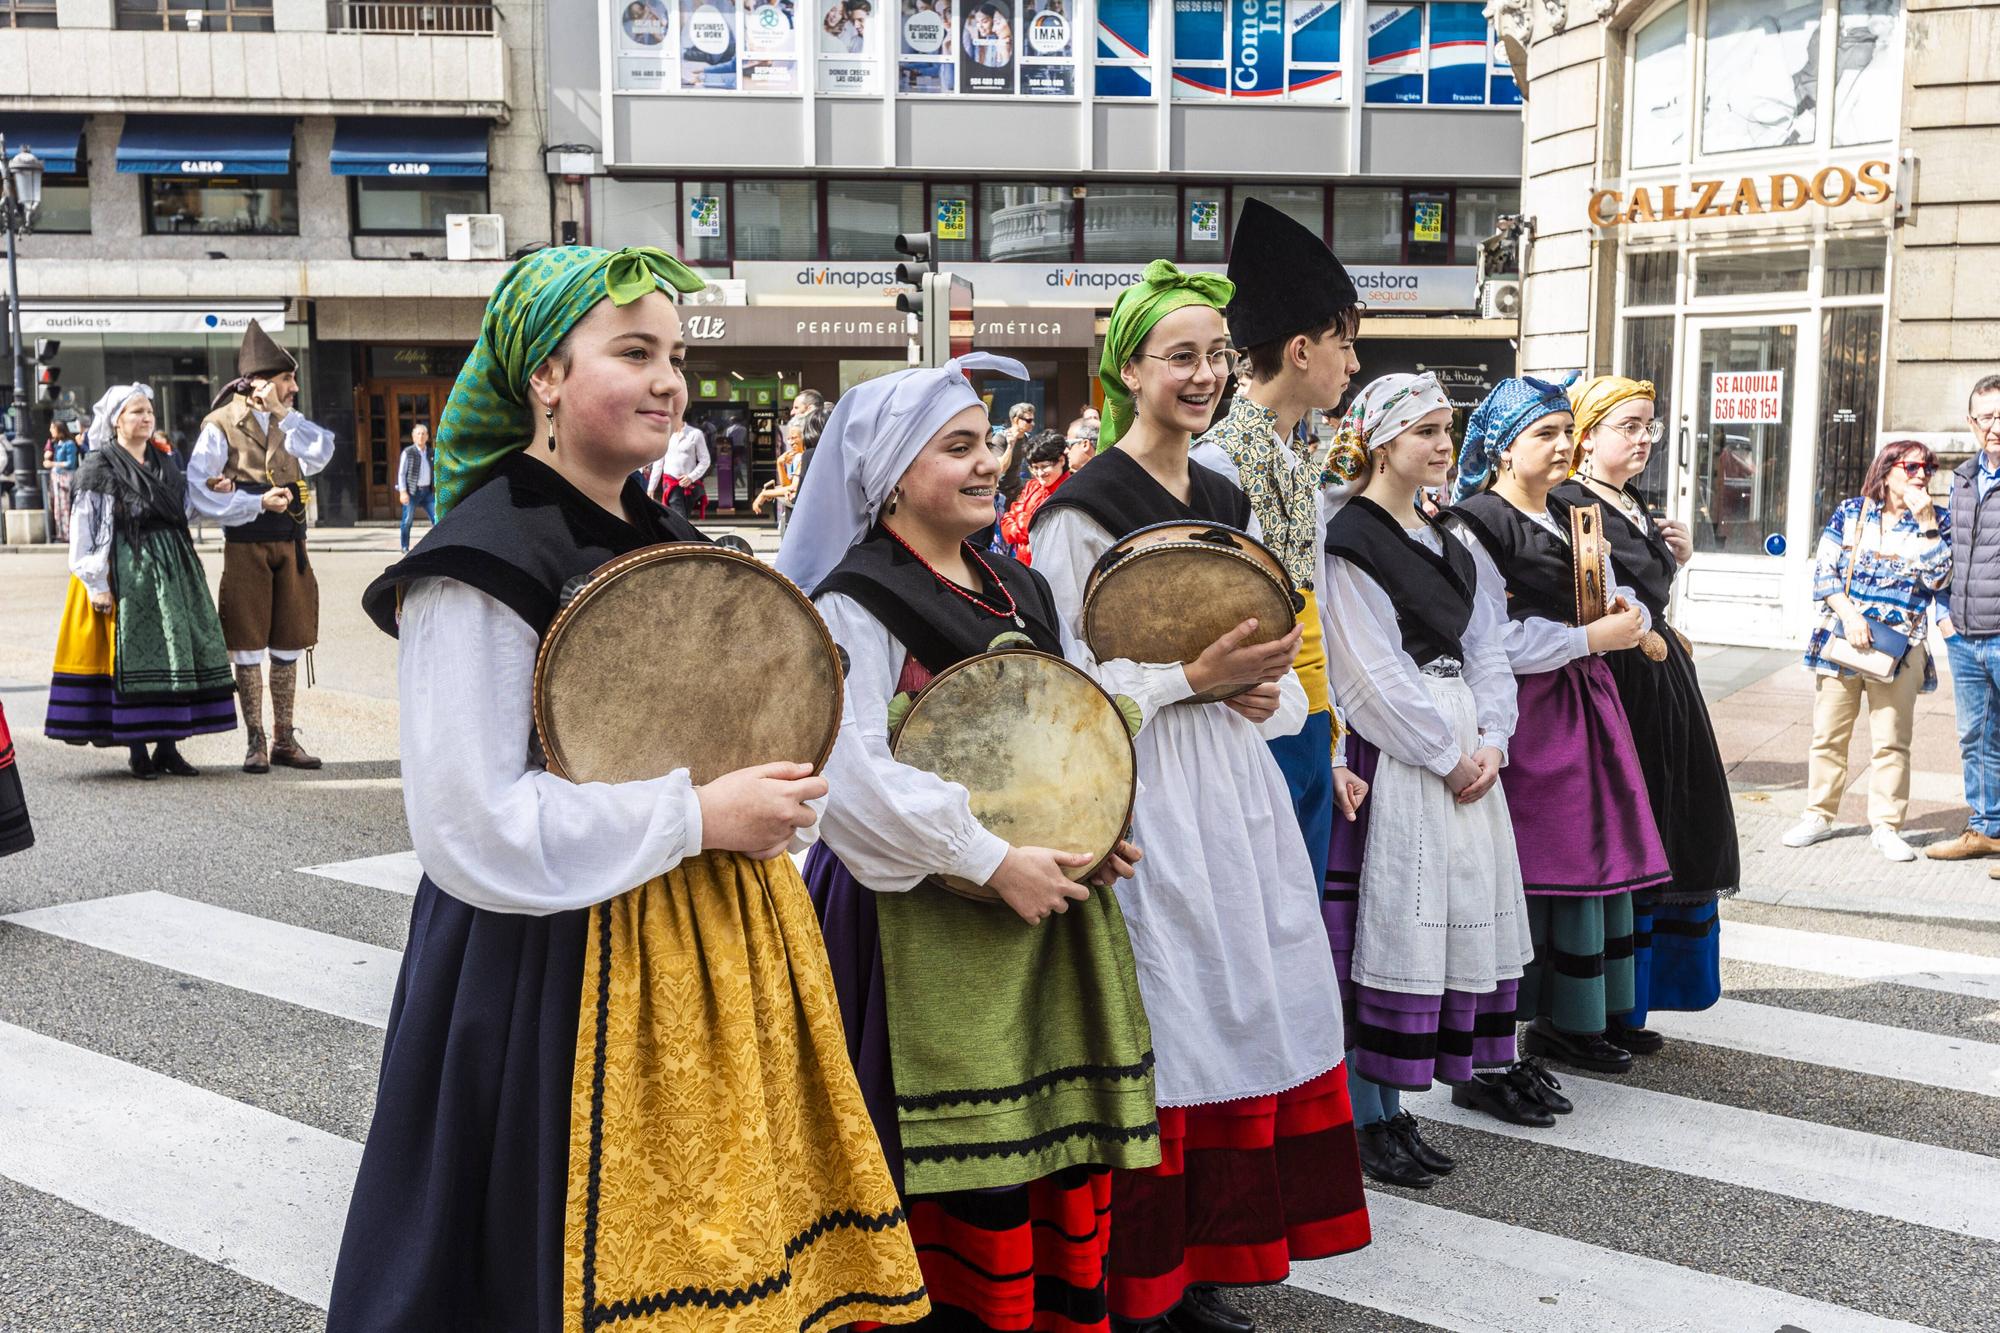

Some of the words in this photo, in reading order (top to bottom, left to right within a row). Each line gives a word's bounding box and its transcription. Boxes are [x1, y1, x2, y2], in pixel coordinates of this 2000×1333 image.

[1259, 0, 1281, 34] In
[693, 23, 725, 31] BUSINESS
[908, 24, 939, 32] BUSINESS
[696, 31, 701, 39] &
[703, 31, 722, 39] WORK
[918, 32, 937, 40] WORK
[1034, 28, 1064, 40] IMAN
[1234, 0, 1259, 90] Come
[1395, 93, 1421, 102] inglés
[1453, 93, 1483, 101] francés
[180, 161, 223, 173] CARLO
[388, 163, 431, 175] CARLO
[1587, 160, 1891, 228] CALZADOS
[1198, 224, 1217, 232] 868
[1046, 269, 1143, 290] divinapas
[1368, 290, 1418, 304] seguros
[796, 319, 906, 334] PERFUMERÍ
[972, 320, 1062, 335] SMÉTICA
[1454, 370, 1484, 385] things
[1716, 376, 1729, 393] SE
[1731, 375, 1778, 394] ALQUILA
[1715, 398, 1735, 420] 636
[1737, 398, 1757, 419] 468
[1760, 397, 1777, 419] 154
